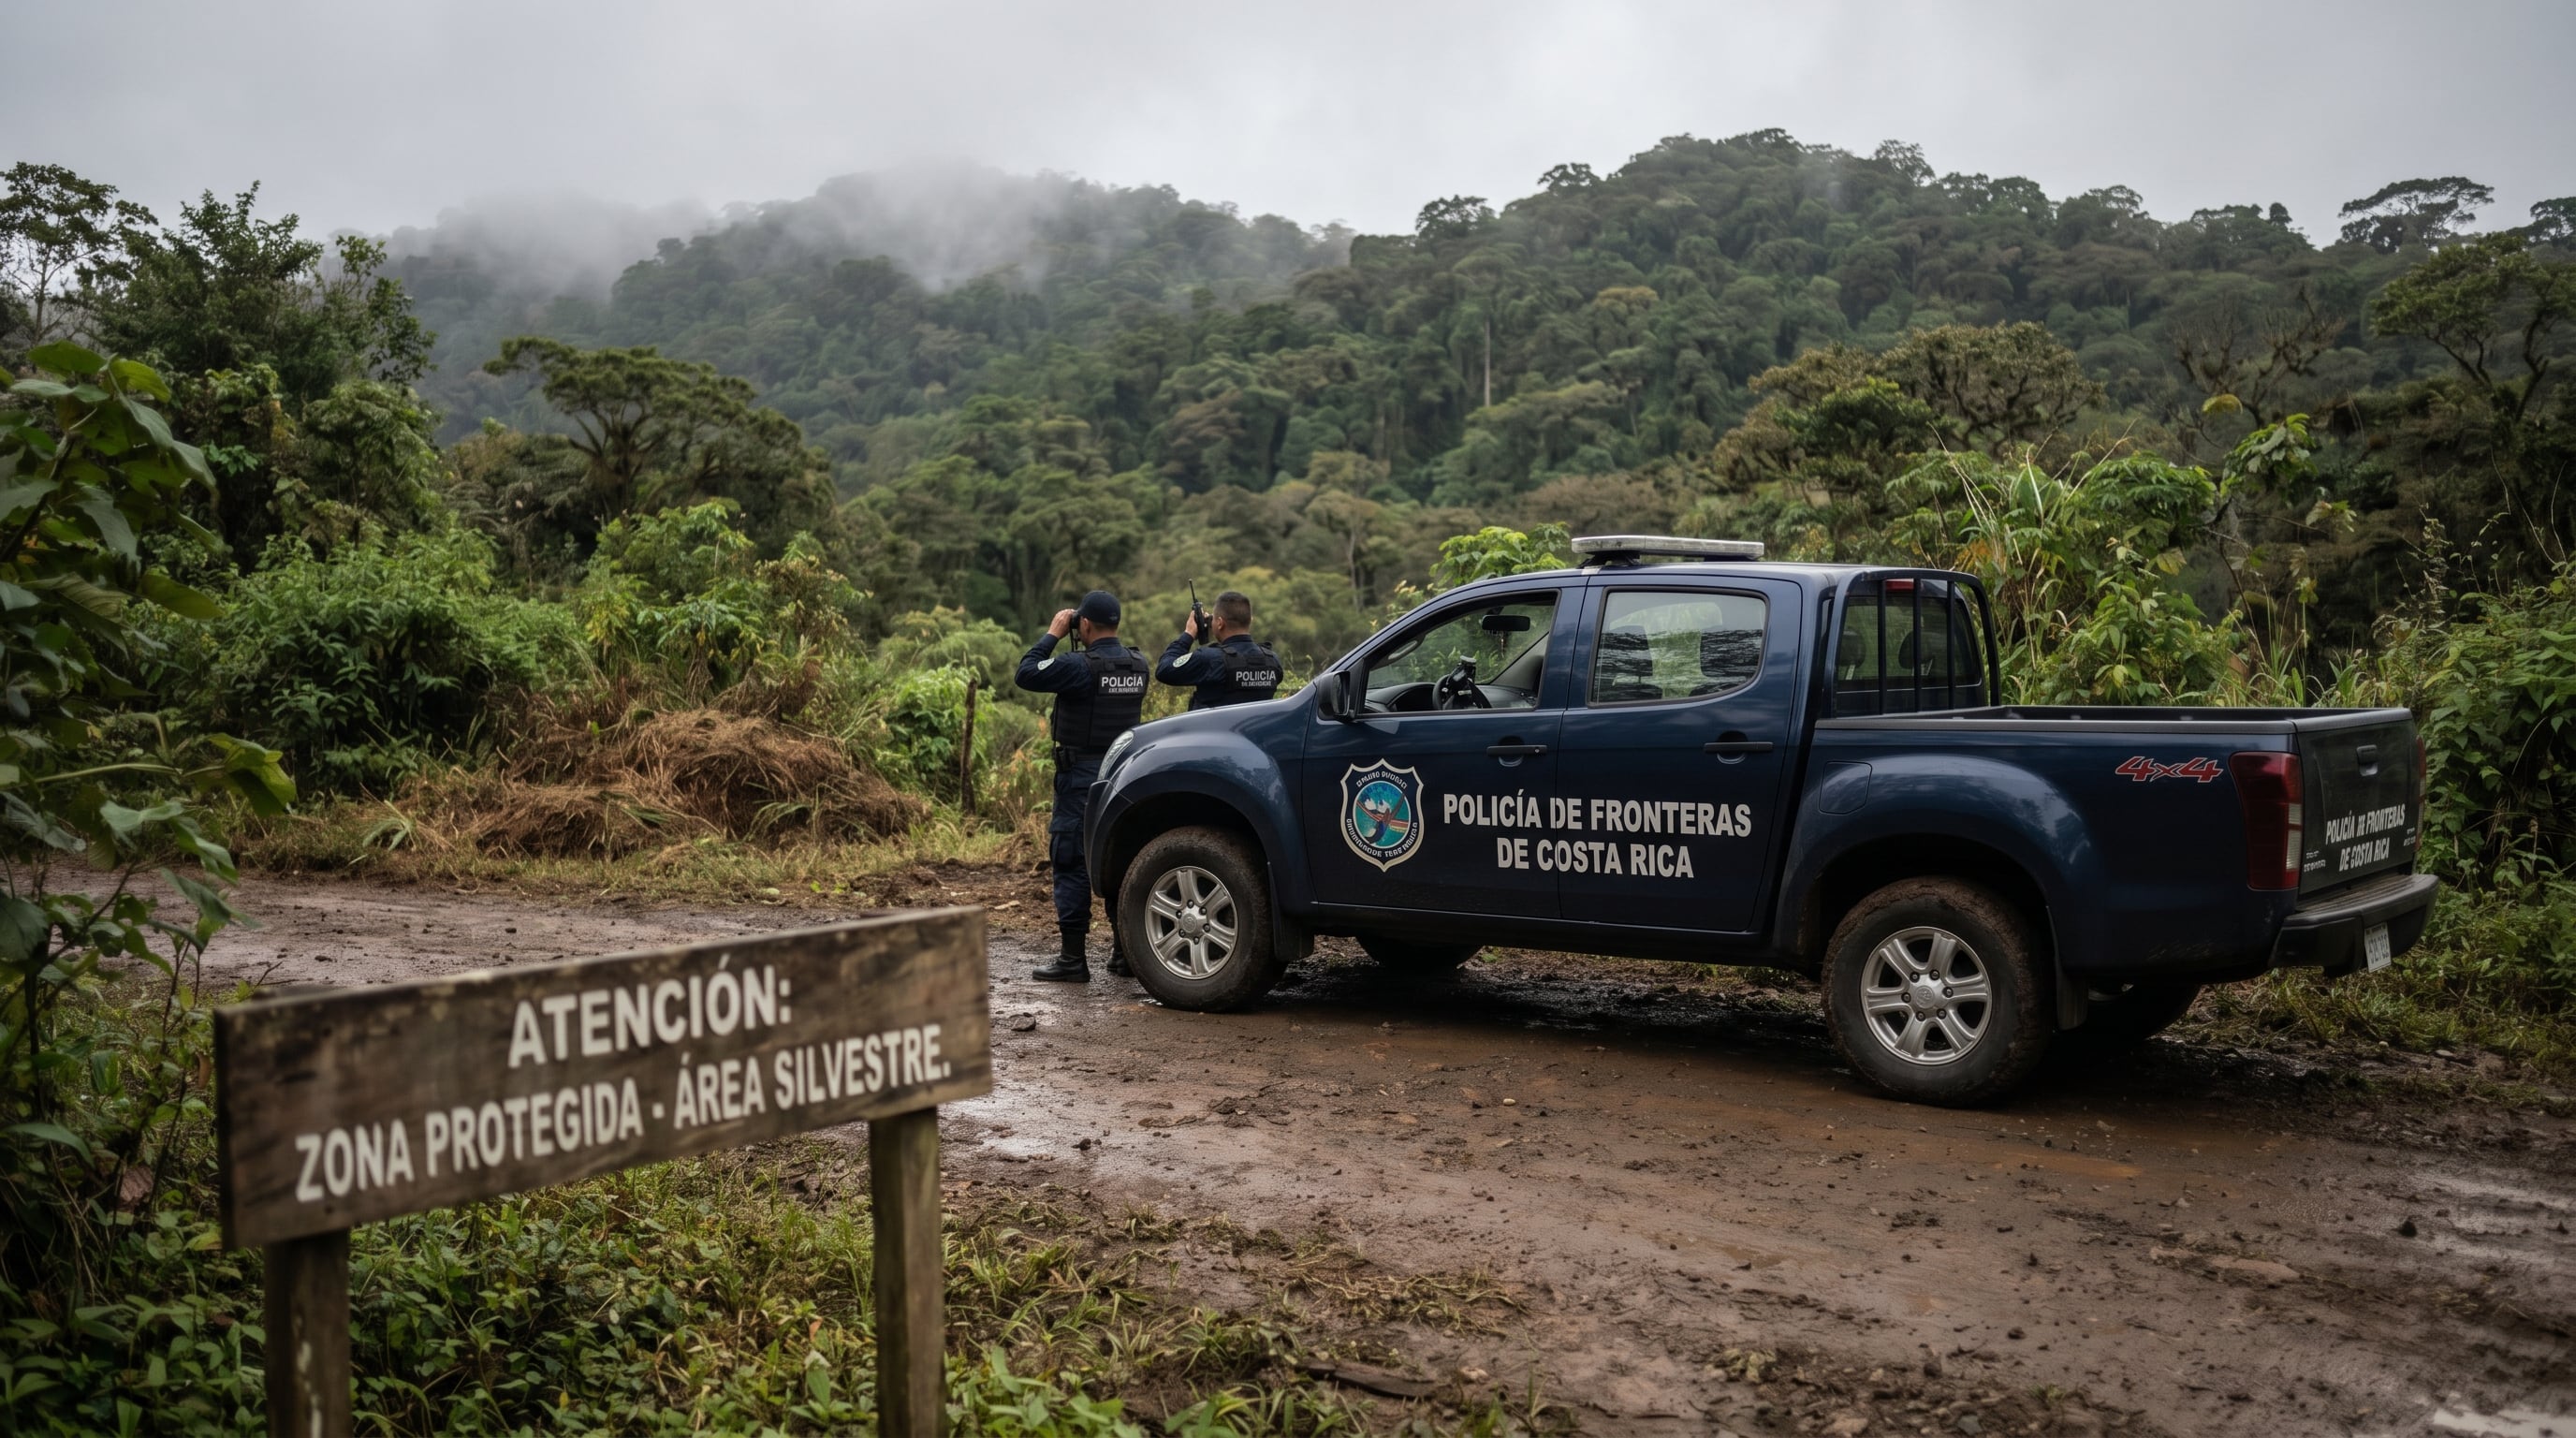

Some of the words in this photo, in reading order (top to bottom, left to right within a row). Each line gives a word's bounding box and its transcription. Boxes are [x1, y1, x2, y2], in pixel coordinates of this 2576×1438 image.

[2115, 756, 2224, 783] 4x4
[1443, 788, 1543, 829] POLICÍA
[1550, 797, 1583, 830] DE
[1590, 799, 1752, 837] FRONTERAS
[2325, 810, 2356, 845] POLICÍA
[2365, 803, 2406, 835] FRONTERAS
[1497, 837, 1530, 870] DE
[1536, 839, 1624, 875] COSTA
[1630, 844, 1694, 878] RICA
[2339, 847, 2351, 872] DE
[2373, 837, 2391, 862] RICA
[508, 953, 792, 1068] ATENCIÓN:
[294, 1124, 415, 1202] ZONA
[425, 1078, 643, 1179] PROTEGIDA
[674, 1051, 766, 1130] ÁREA
[773, 1024, 952, 1109] SILVESTRE.
